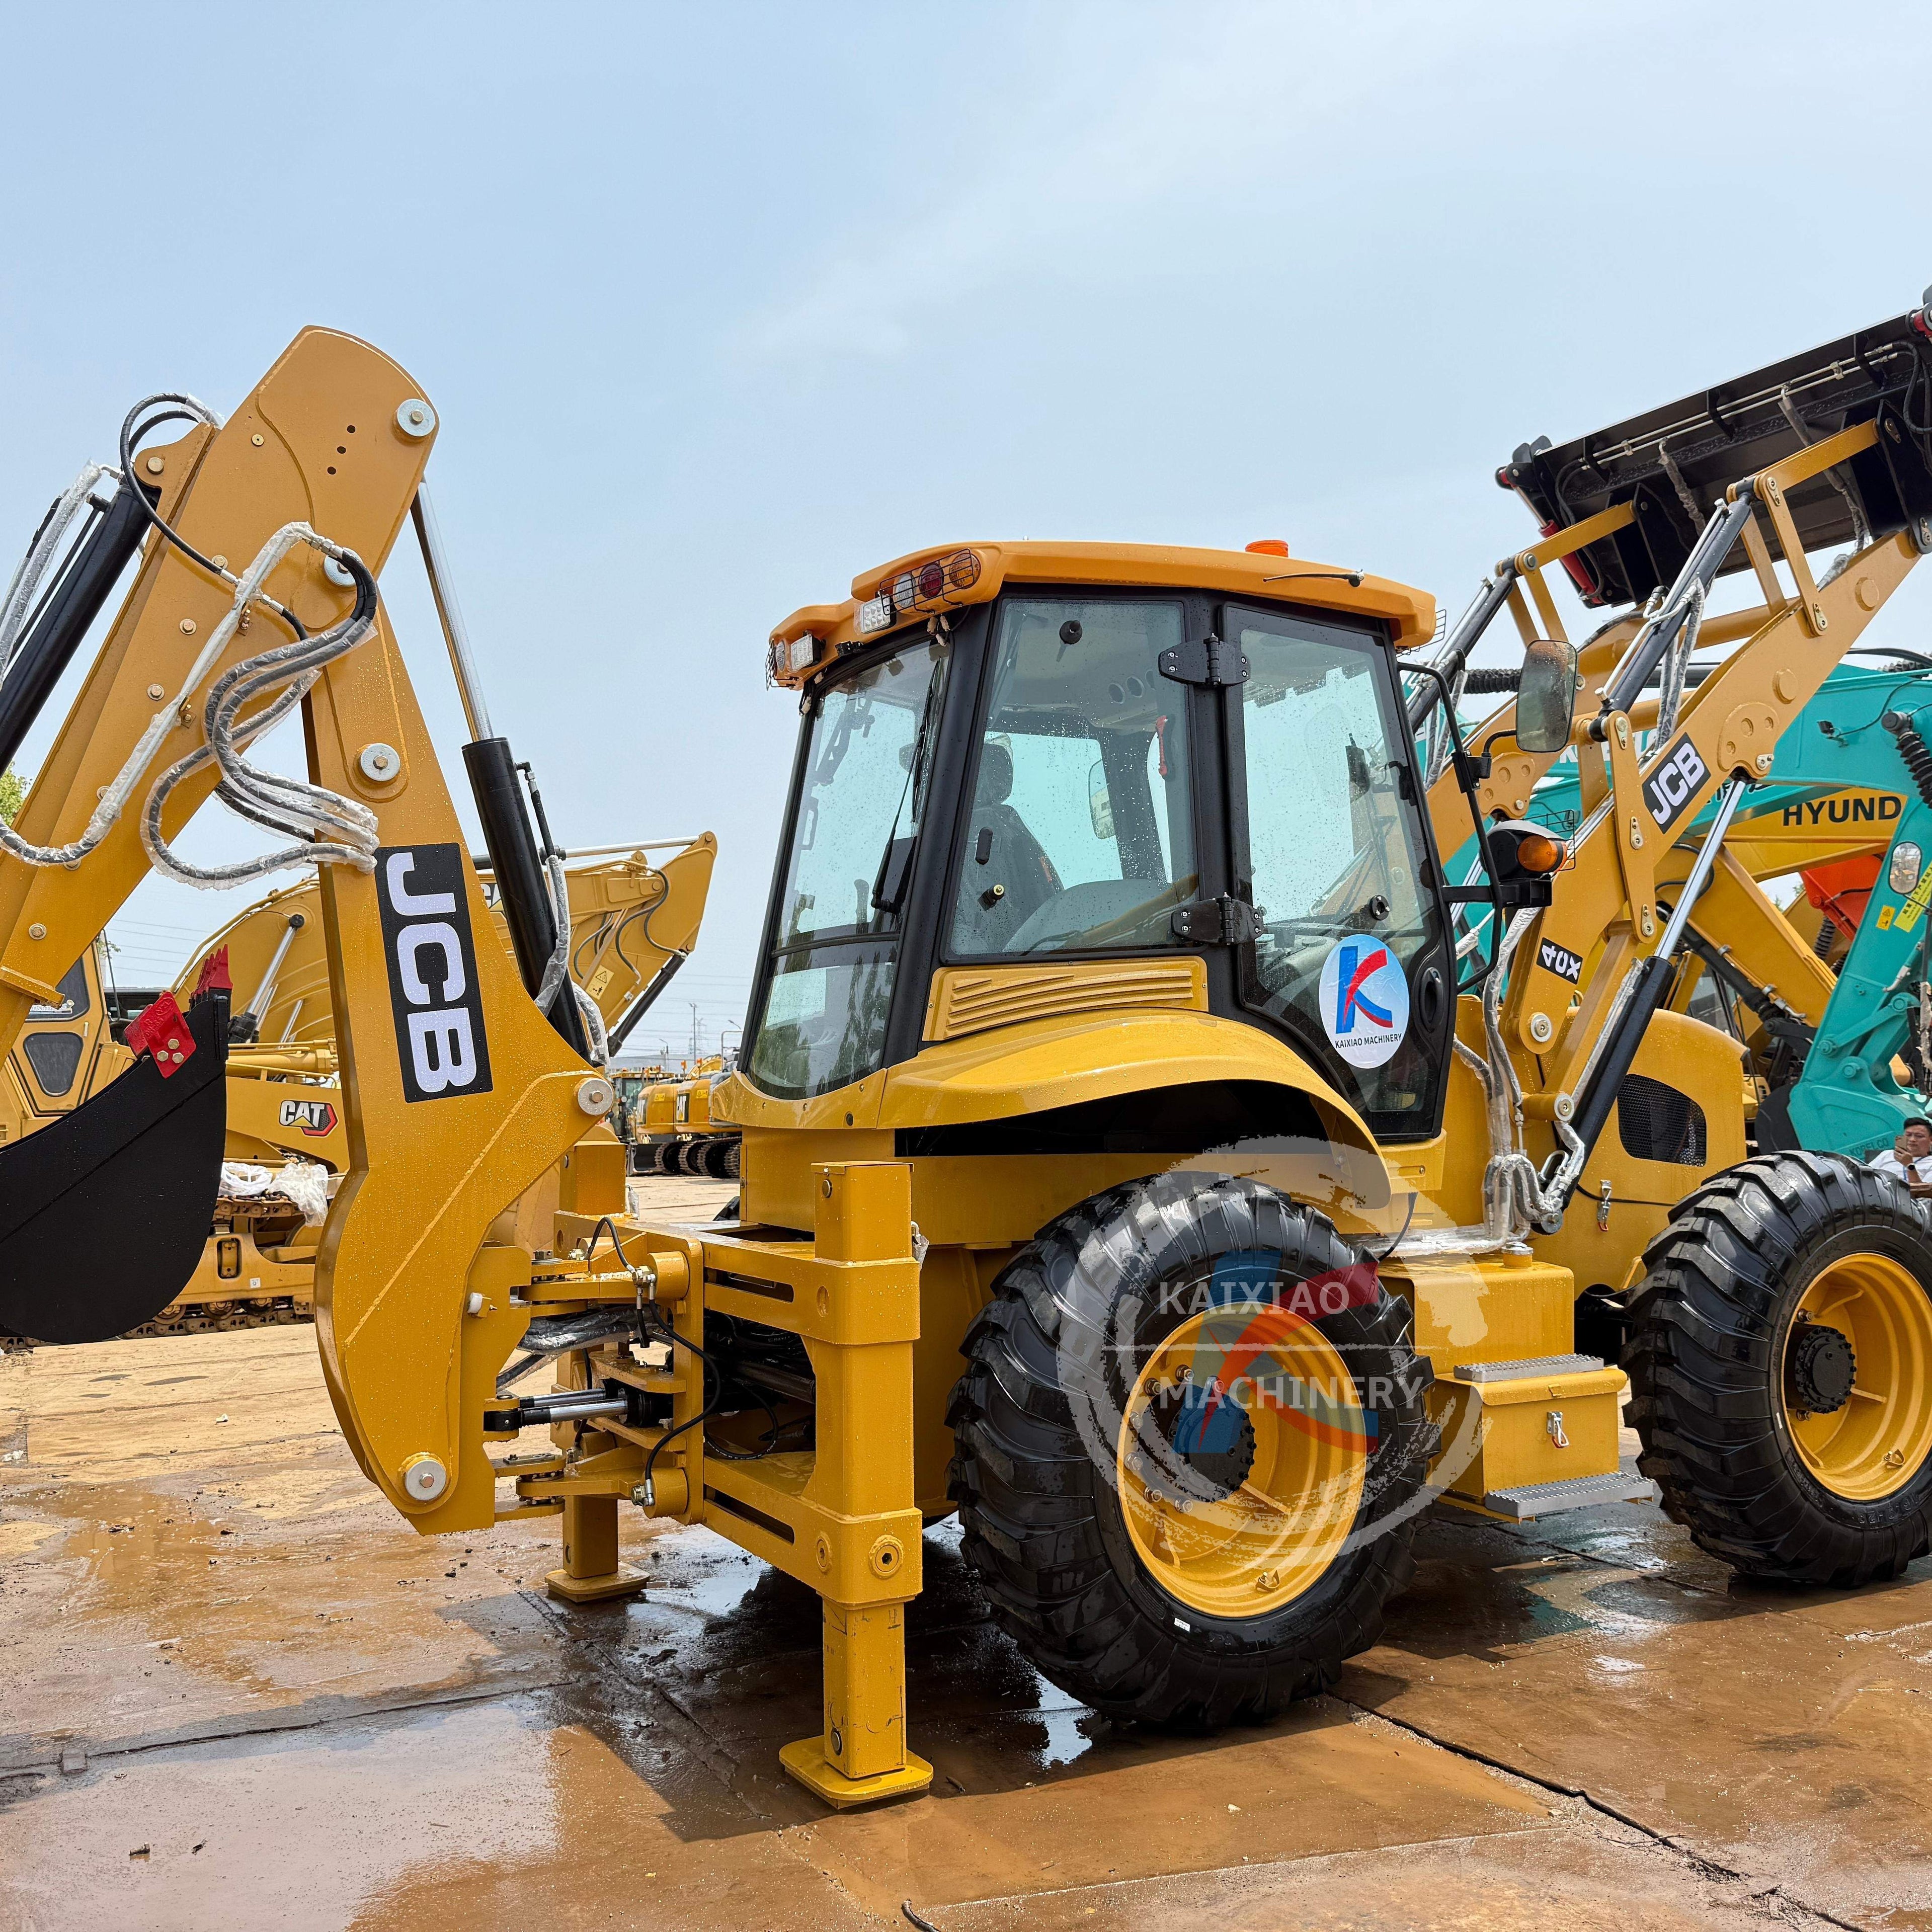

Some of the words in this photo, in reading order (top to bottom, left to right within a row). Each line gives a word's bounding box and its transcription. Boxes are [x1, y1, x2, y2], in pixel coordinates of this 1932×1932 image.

[1650, 743, 1705, 824] JCB
[1783, 796, 1901, 826] HYUND
[386, 852, 477, 1093] JCB
[1335, 1038, 1362, 1049] KAIXIAO
[1364, 1033, 1402, 1045] MACHINERY
[279, 1100, 325, 1128] CAT
